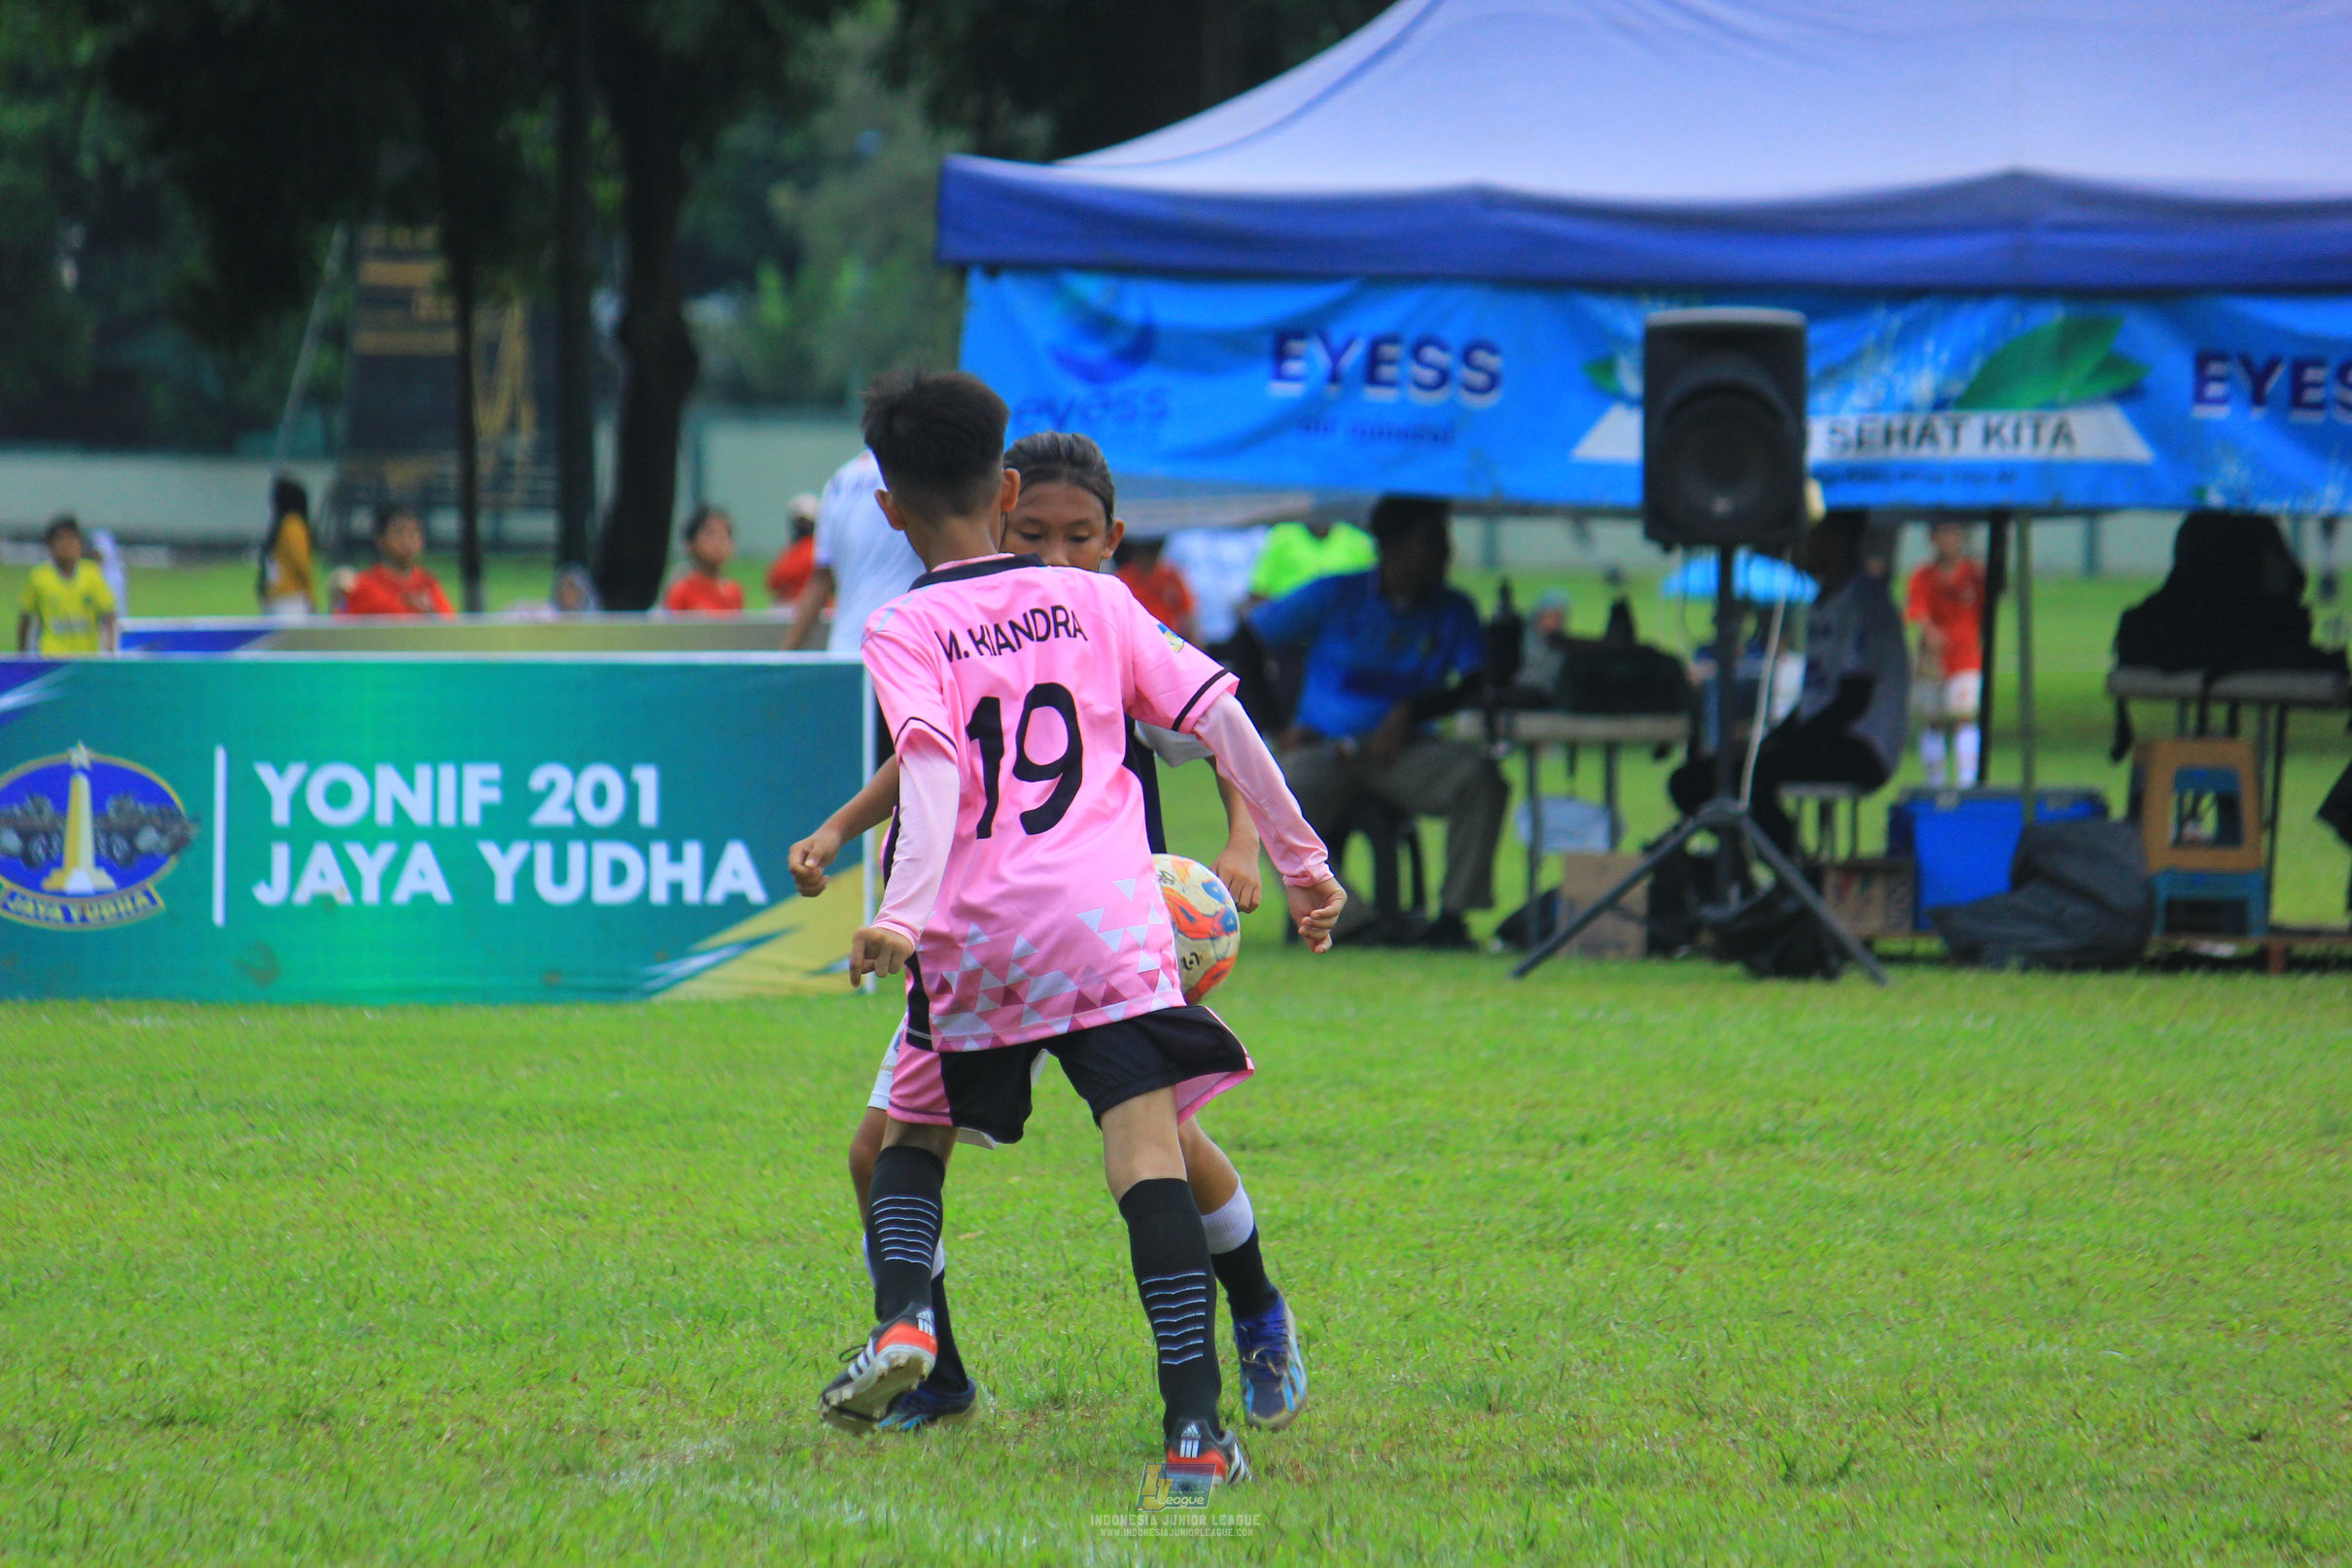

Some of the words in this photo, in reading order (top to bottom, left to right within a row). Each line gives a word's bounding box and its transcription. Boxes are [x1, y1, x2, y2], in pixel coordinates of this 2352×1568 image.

[1268, 329, 1503, 407] EYESS
[1828, 412, 1964, 453] SEHAT
[1983, 413, 2078, 452] KITA
[966, 605, 1088, 656] KIANDRA
[965, 681, 1084, 840] 19
[253, 761, 503, 828] YONIF
[529, 762, 660, 828] 201
[252, 841, 454, 906] JAYA
[476, 841, 768, 906] YUDHA
